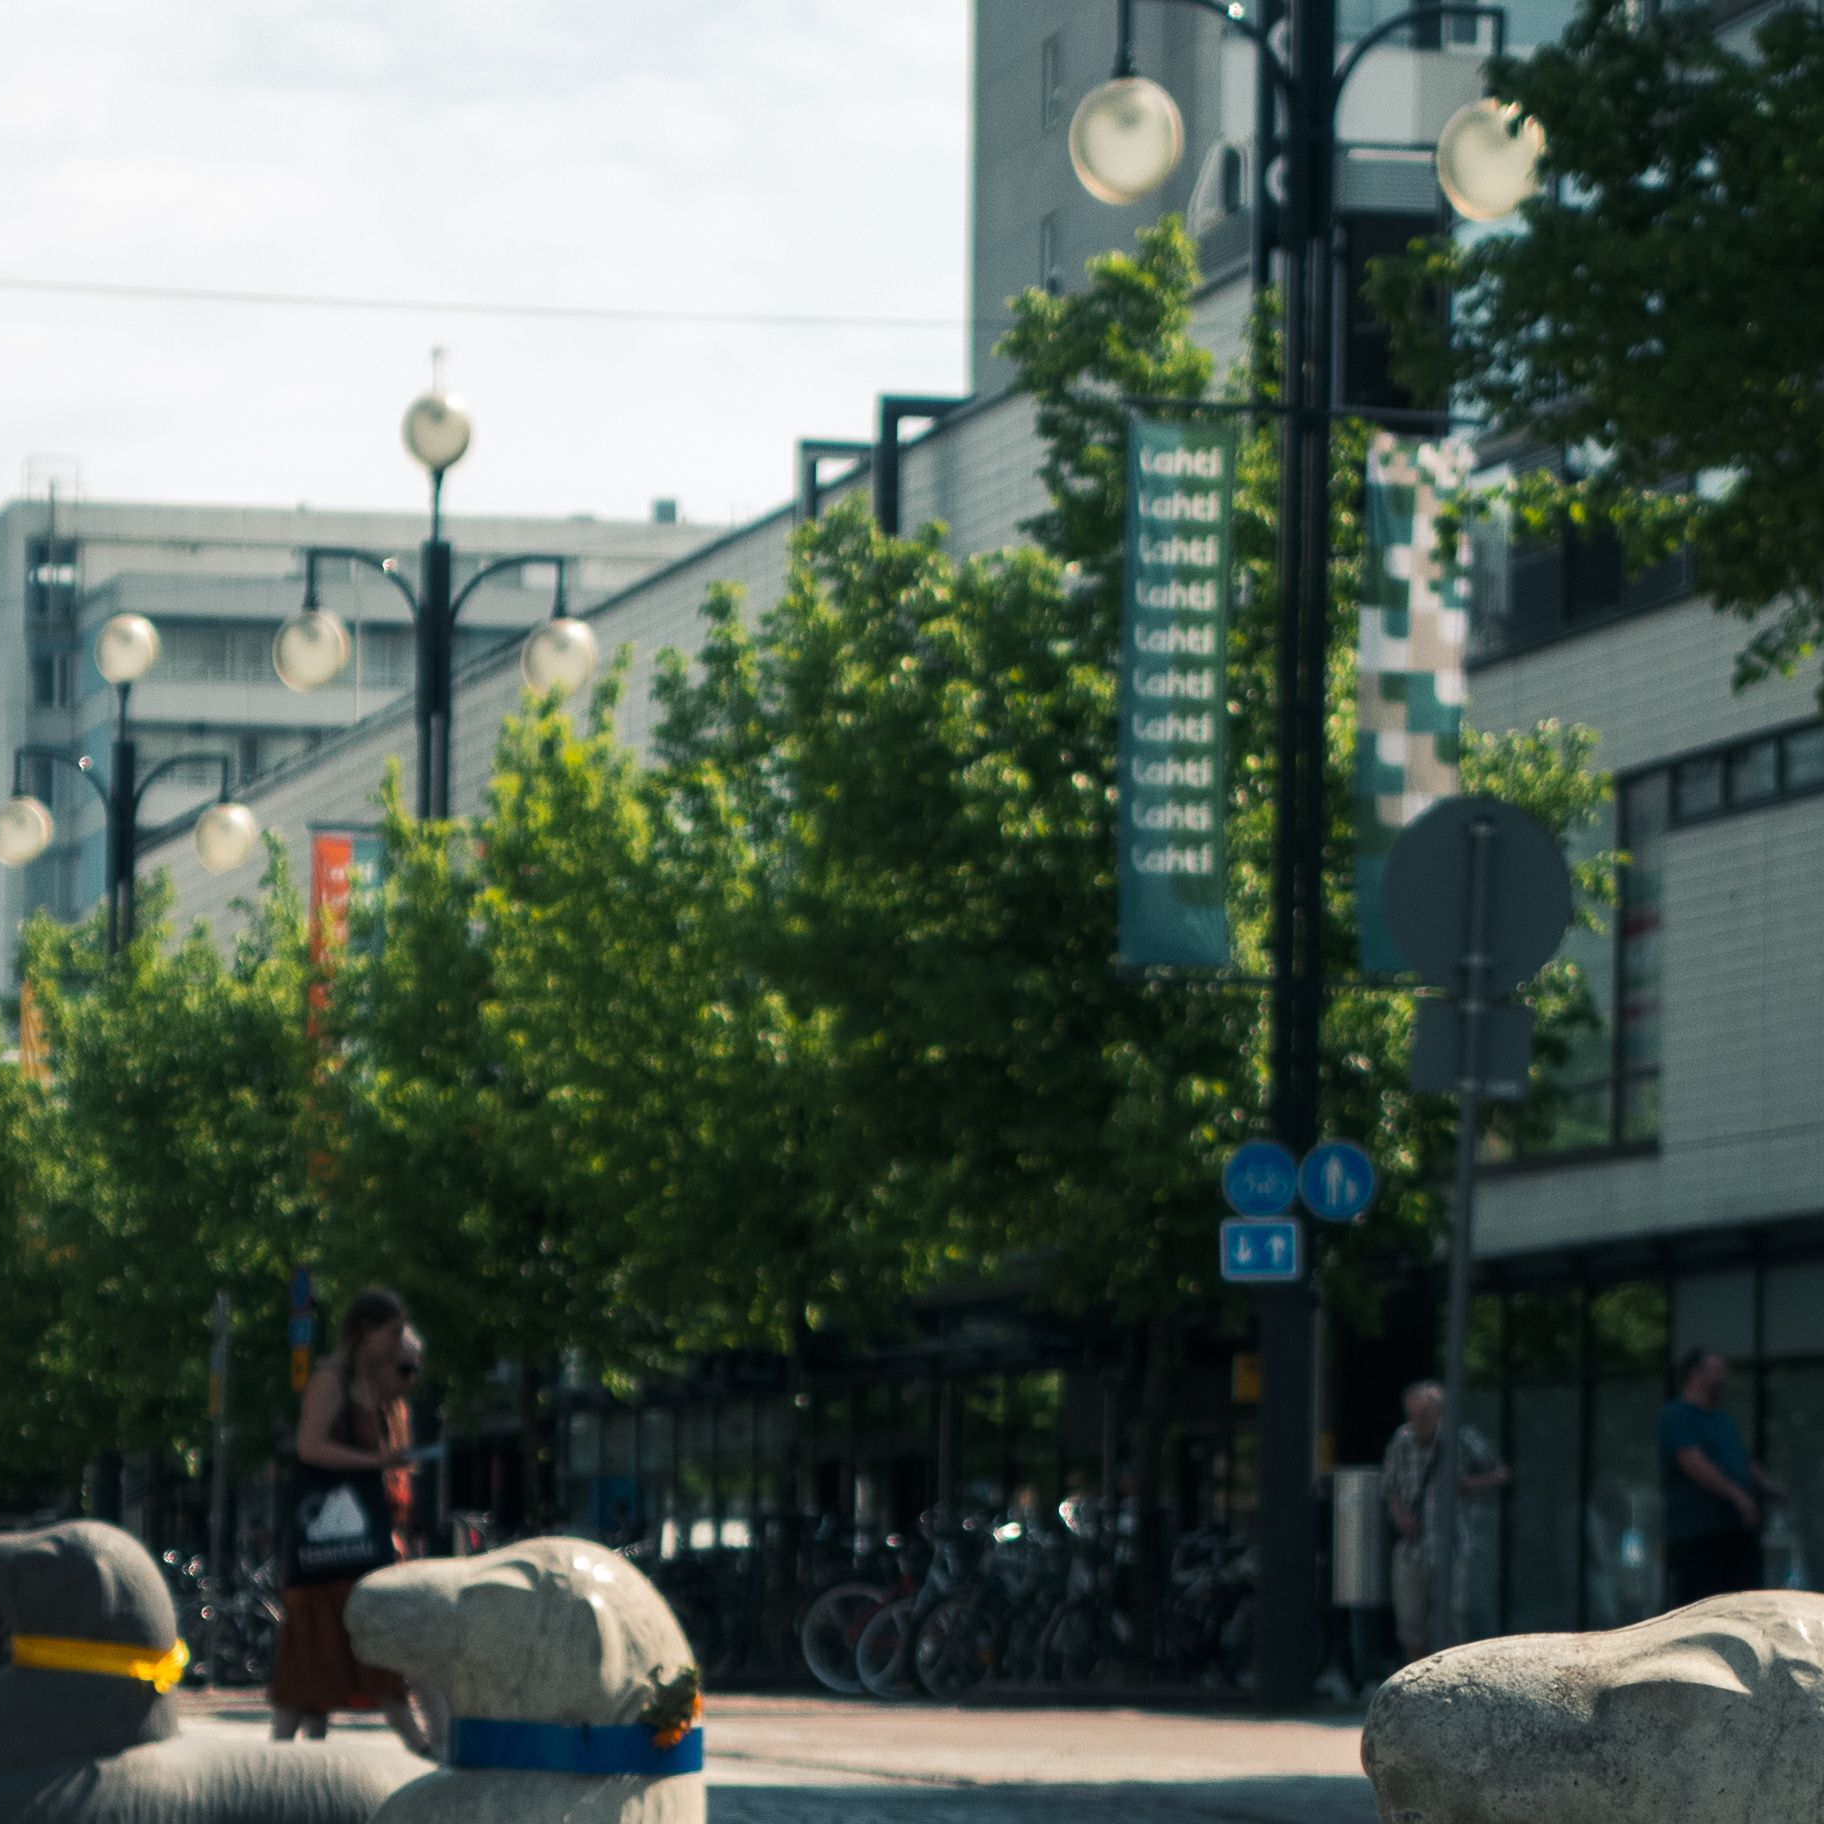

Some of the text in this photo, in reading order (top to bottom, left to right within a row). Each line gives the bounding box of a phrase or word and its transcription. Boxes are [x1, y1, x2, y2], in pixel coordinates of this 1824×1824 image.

[1139, 447, 1223, 477] Lahti
[1138, 490, 1221, 521] Lahti
[1138, 533, 1219, 566] Lahti
[1135, 580, 1218, 610] Lahti
[1133, 624, 1216, 655] Lahti
[1132, 667, 1215, 698] Lahti
[1132, 712, 1214, 743] Lahti
[1131, 756, 1214, 787] Lahti
[1131, 799, 1213, 831] Lahti
[1132, 843, 1213, 874] Lahti
